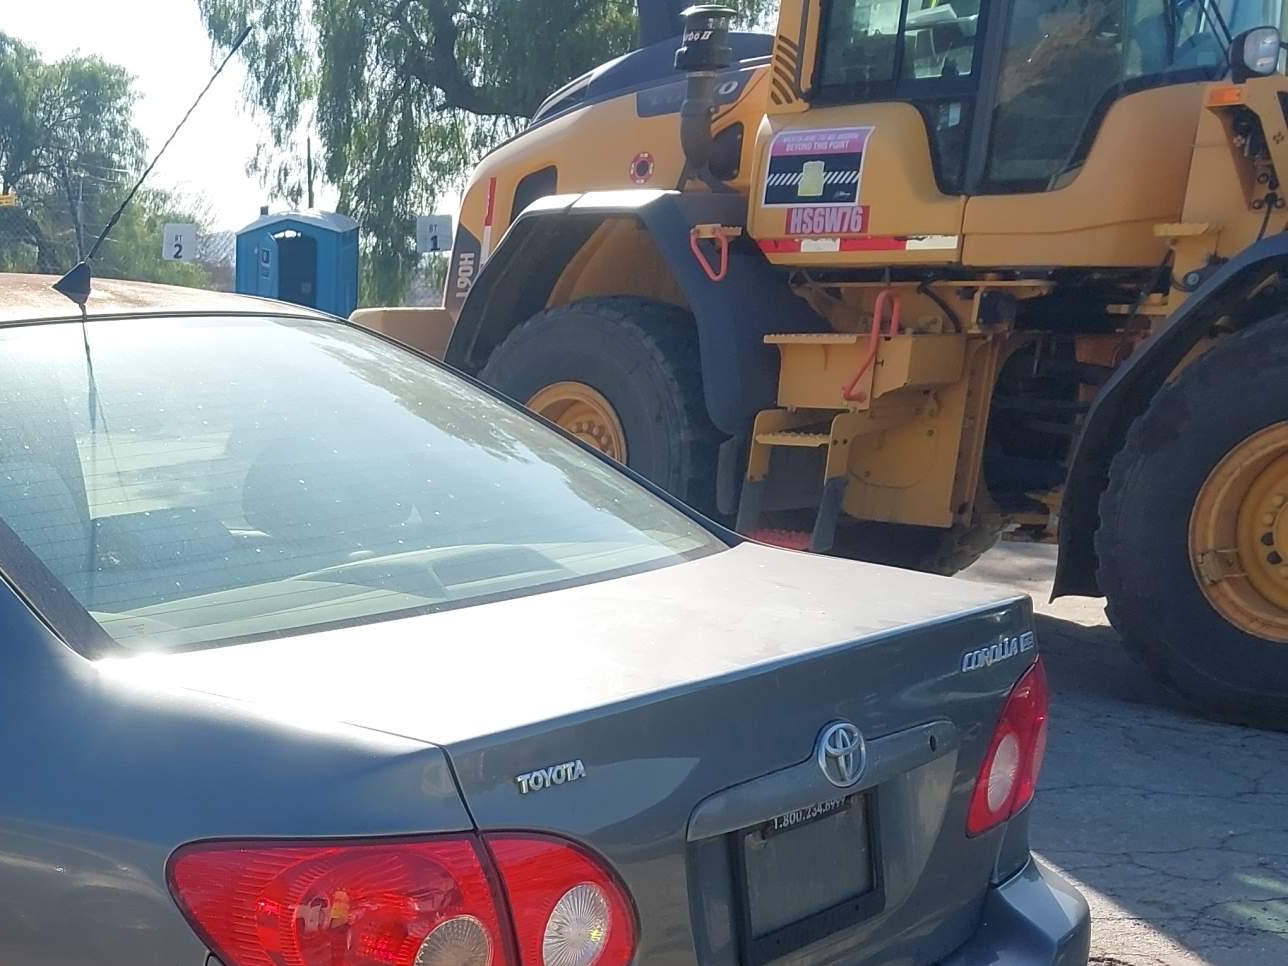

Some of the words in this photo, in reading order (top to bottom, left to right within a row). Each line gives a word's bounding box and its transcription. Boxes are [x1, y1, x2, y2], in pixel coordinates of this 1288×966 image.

[790, 206, 864, 234] HS6W76
[173, 243, 183, 259] 2
[429, 234, 441, 252] 1
[961, 636, 1019, 673] COROLLA
[515, 759, 587, 794] TOYOTA
